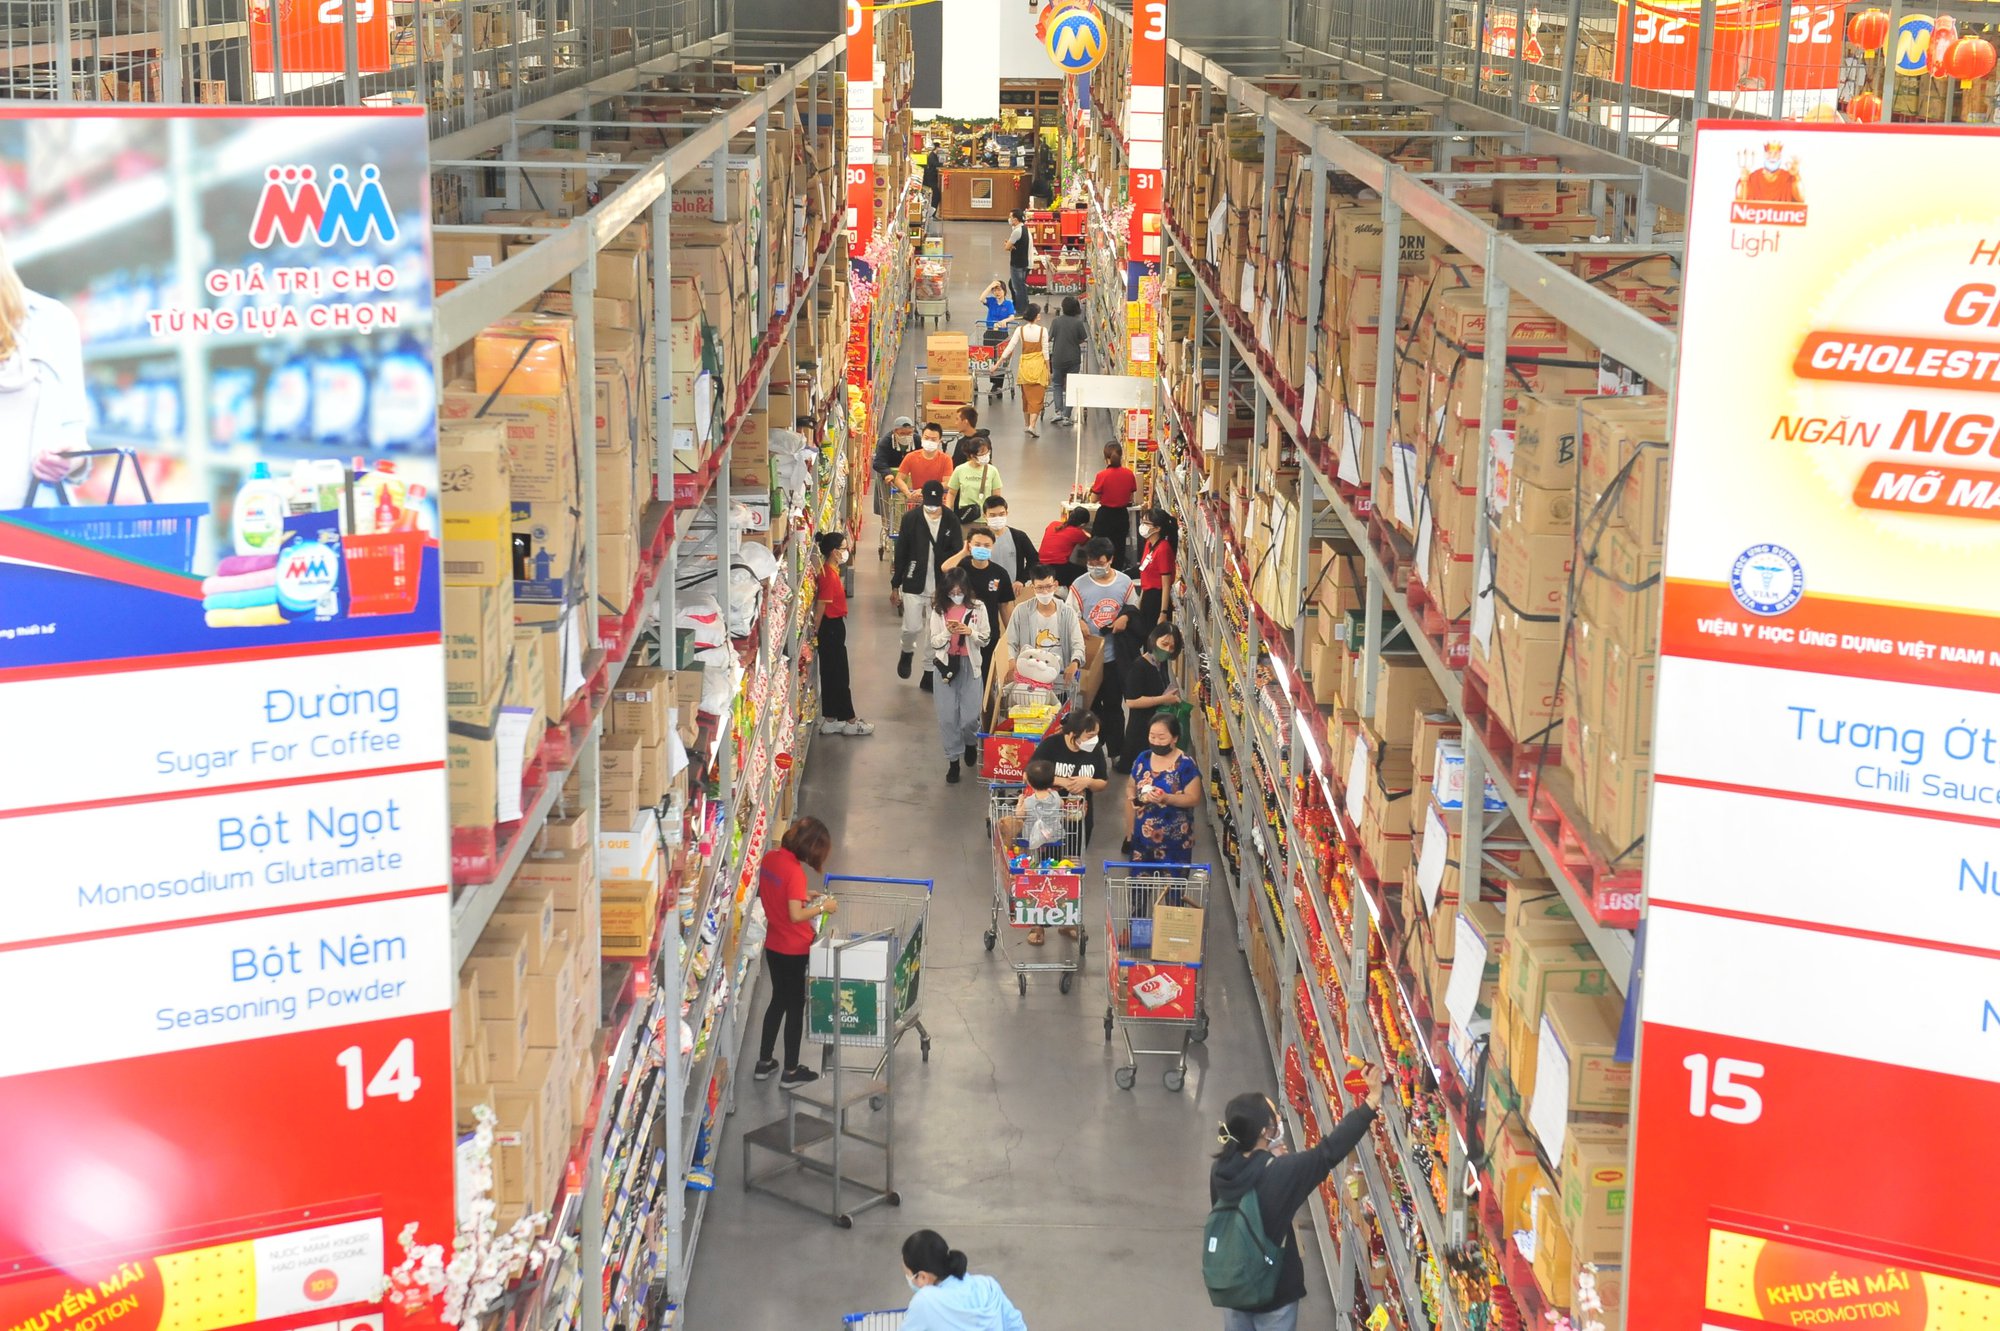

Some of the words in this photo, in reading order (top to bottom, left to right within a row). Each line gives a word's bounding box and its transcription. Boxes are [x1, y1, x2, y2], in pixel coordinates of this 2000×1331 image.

[1634, 10, 1687, 44] 32
[1788, 6, 1834, 44] 32
[1137, 174, 1154, 189] 31
[1733, 205, 1806, 223] Neptune
[1731, 229, 1781, 257] Light
[1969, 238, 2000, 266] H
[210, 264, 263, 292] GIÁ
[279, 268, 320, 294] TRỊ
[332, 267, 396, 291] CHO
[151, 309, 235, 333] TỪNG
[247, 306, 298, 337] LỰA
[310, 306, 398, 332] CHỌN
[1559, 435, 1574, 464] B
[1770, 415, 1881, 448] NGĂN
[1889, 409, 2000, 462] NG
[1871, 470, 1942, 503] MỠ
[1358, 500, 1371, 511] LO
[1697, 617, 1738, 638] VIỆN
[1742, 623, 1755, 637] Y
[1758, 625, 1795, 644] HỌC
[1799, 627, 1837, 648] ỨNG
[1841, 635, 1893, 654] DỤNG
[1898, 640, 1936, 661] VIỆT
[1940, 646, 1985, 665] NAM
[264, 684, 400, 723] Đường
[1787, 705, 1925, 765] Tương
[1944, 717, 2000, 765] Ớt
[156, 747, 238, 777] Sugar
[251, 741, 298, 764] For
[310, 731, 401, 758] Coffee
[993, 767, 1022, 776] SAIGON
[1854, 765, 1910, 793] Chili
[218, 811, 289, 853] Bột
[307, 799, 401, 848] Ngọt
[78, 869, 254, 907] Monosodium
[264, 850, 403, 885] Glutamate
[231, 942, 303, 983] Bột
[319, 933, 408, 970] Nêm
[156, 995, 297, 1031] Seasoning
[307, 978, 406, 1009] Powder
[336, 1038, 421, 1111] 14
[1683, 1052, 1765, 1125] 15
[98, 1262, 145, 1298] MÃI
[1766, 1271, 1861, 1306] KHUYẾN
[1865, 1268, 1910, 1294] MÃI
[1790, 1300, 1901, 1327] PROMOTION
